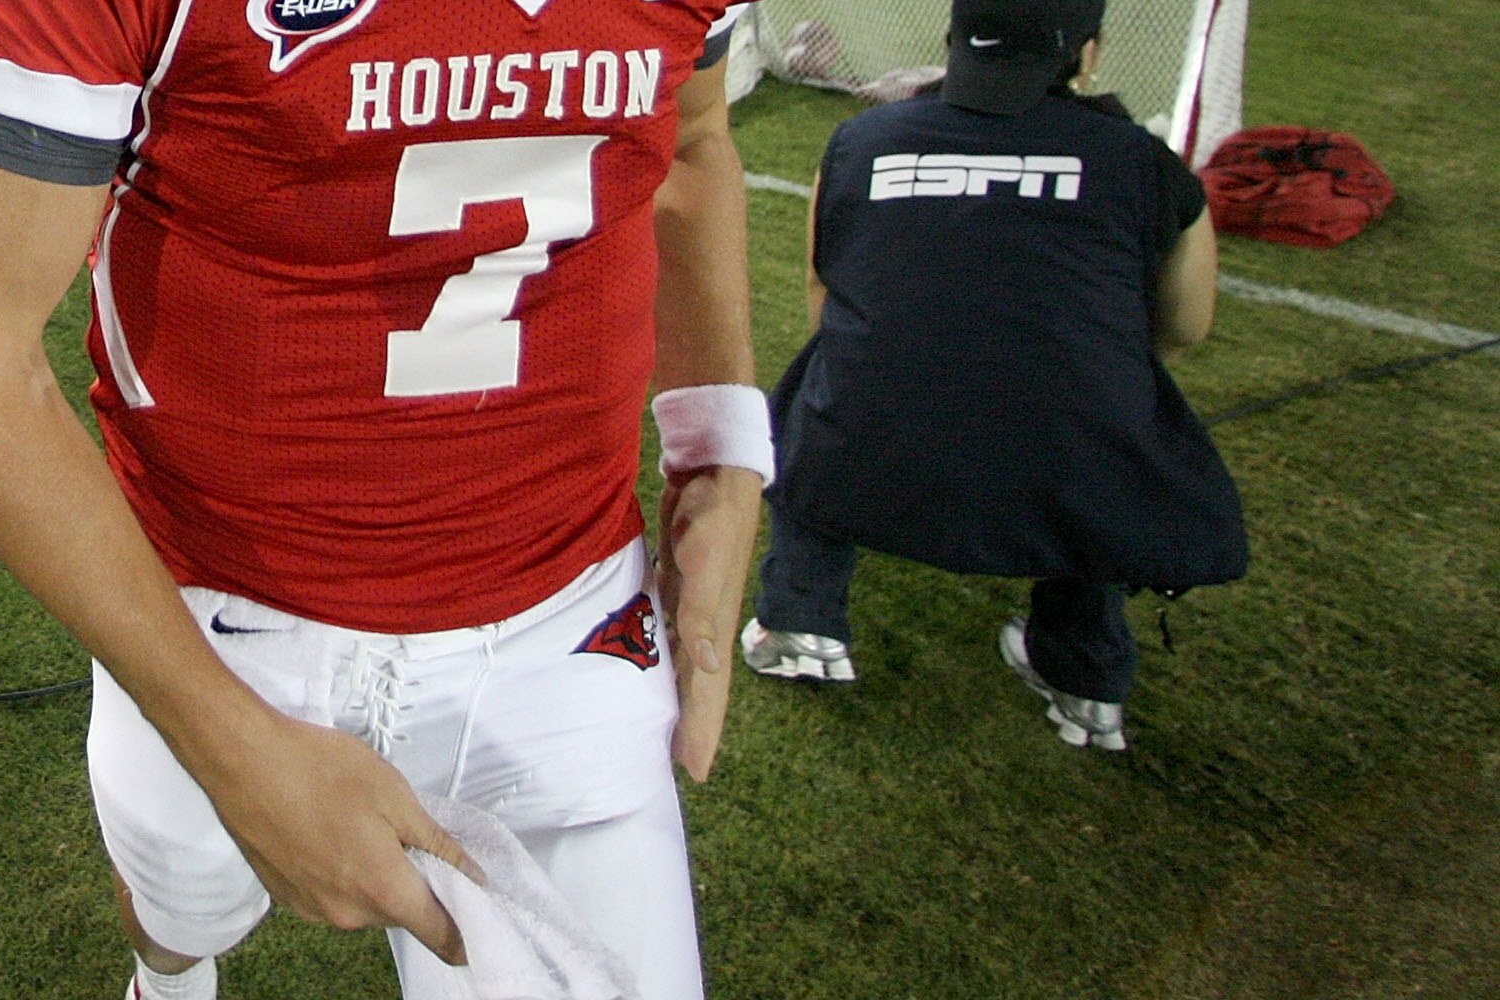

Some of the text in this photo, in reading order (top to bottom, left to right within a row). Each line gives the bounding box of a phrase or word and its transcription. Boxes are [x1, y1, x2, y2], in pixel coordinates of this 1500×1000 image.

[345, 48, 661, 132] HOUSTON
[868, 152, 1084, 201] ESPN
[383, 133, 611, 398] 7
